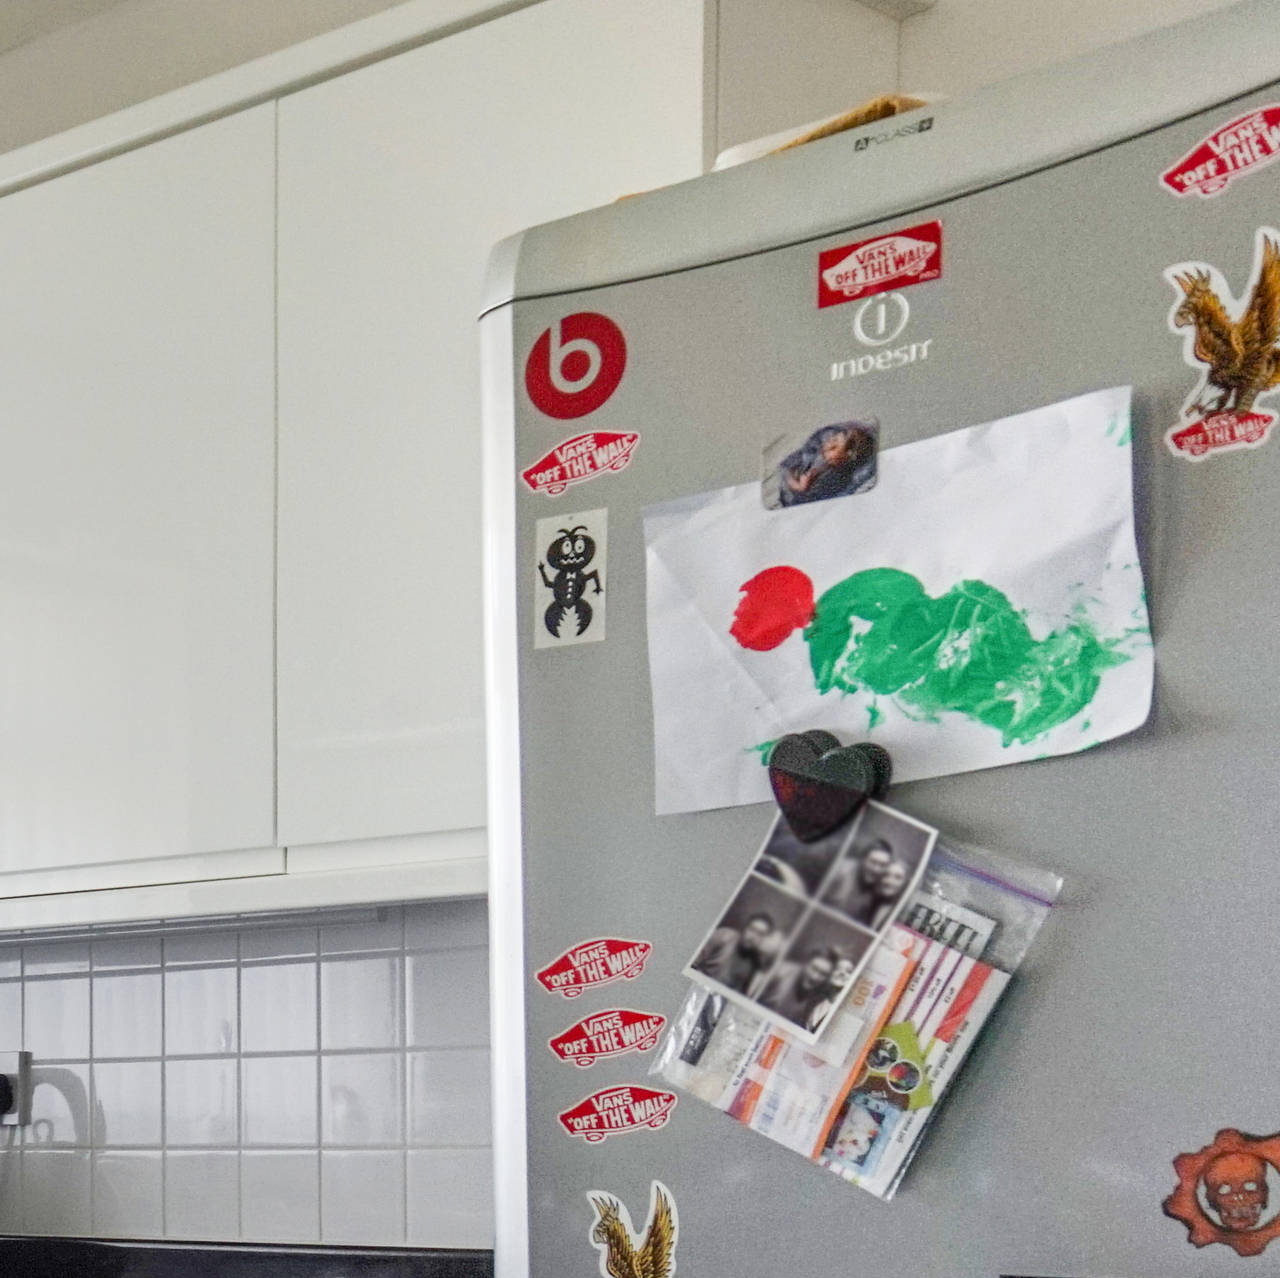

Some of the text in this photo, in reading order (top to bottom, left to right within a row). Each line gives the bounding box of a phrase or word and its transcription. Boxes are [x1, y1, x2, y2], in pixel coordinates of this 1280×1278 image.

[1207, 112, 1269, 154] VANS
[1219, 134, 1263, 171] THE
[856, 240, 897, 265] VANS
[862, 260, 890, 280] THE
[554, 434, 597, 463] VANS
[563, 452, 594, 479] THE
[568, 941, 608, 967] VANS
[576, 958, 608, 982] THE
[581, 1012, 622, 1036] VANS
[589, 1029, 621, 1052] THE
[591, 1088, 633, 1112] VANS
[599, 1104, 631, 1128] THE
